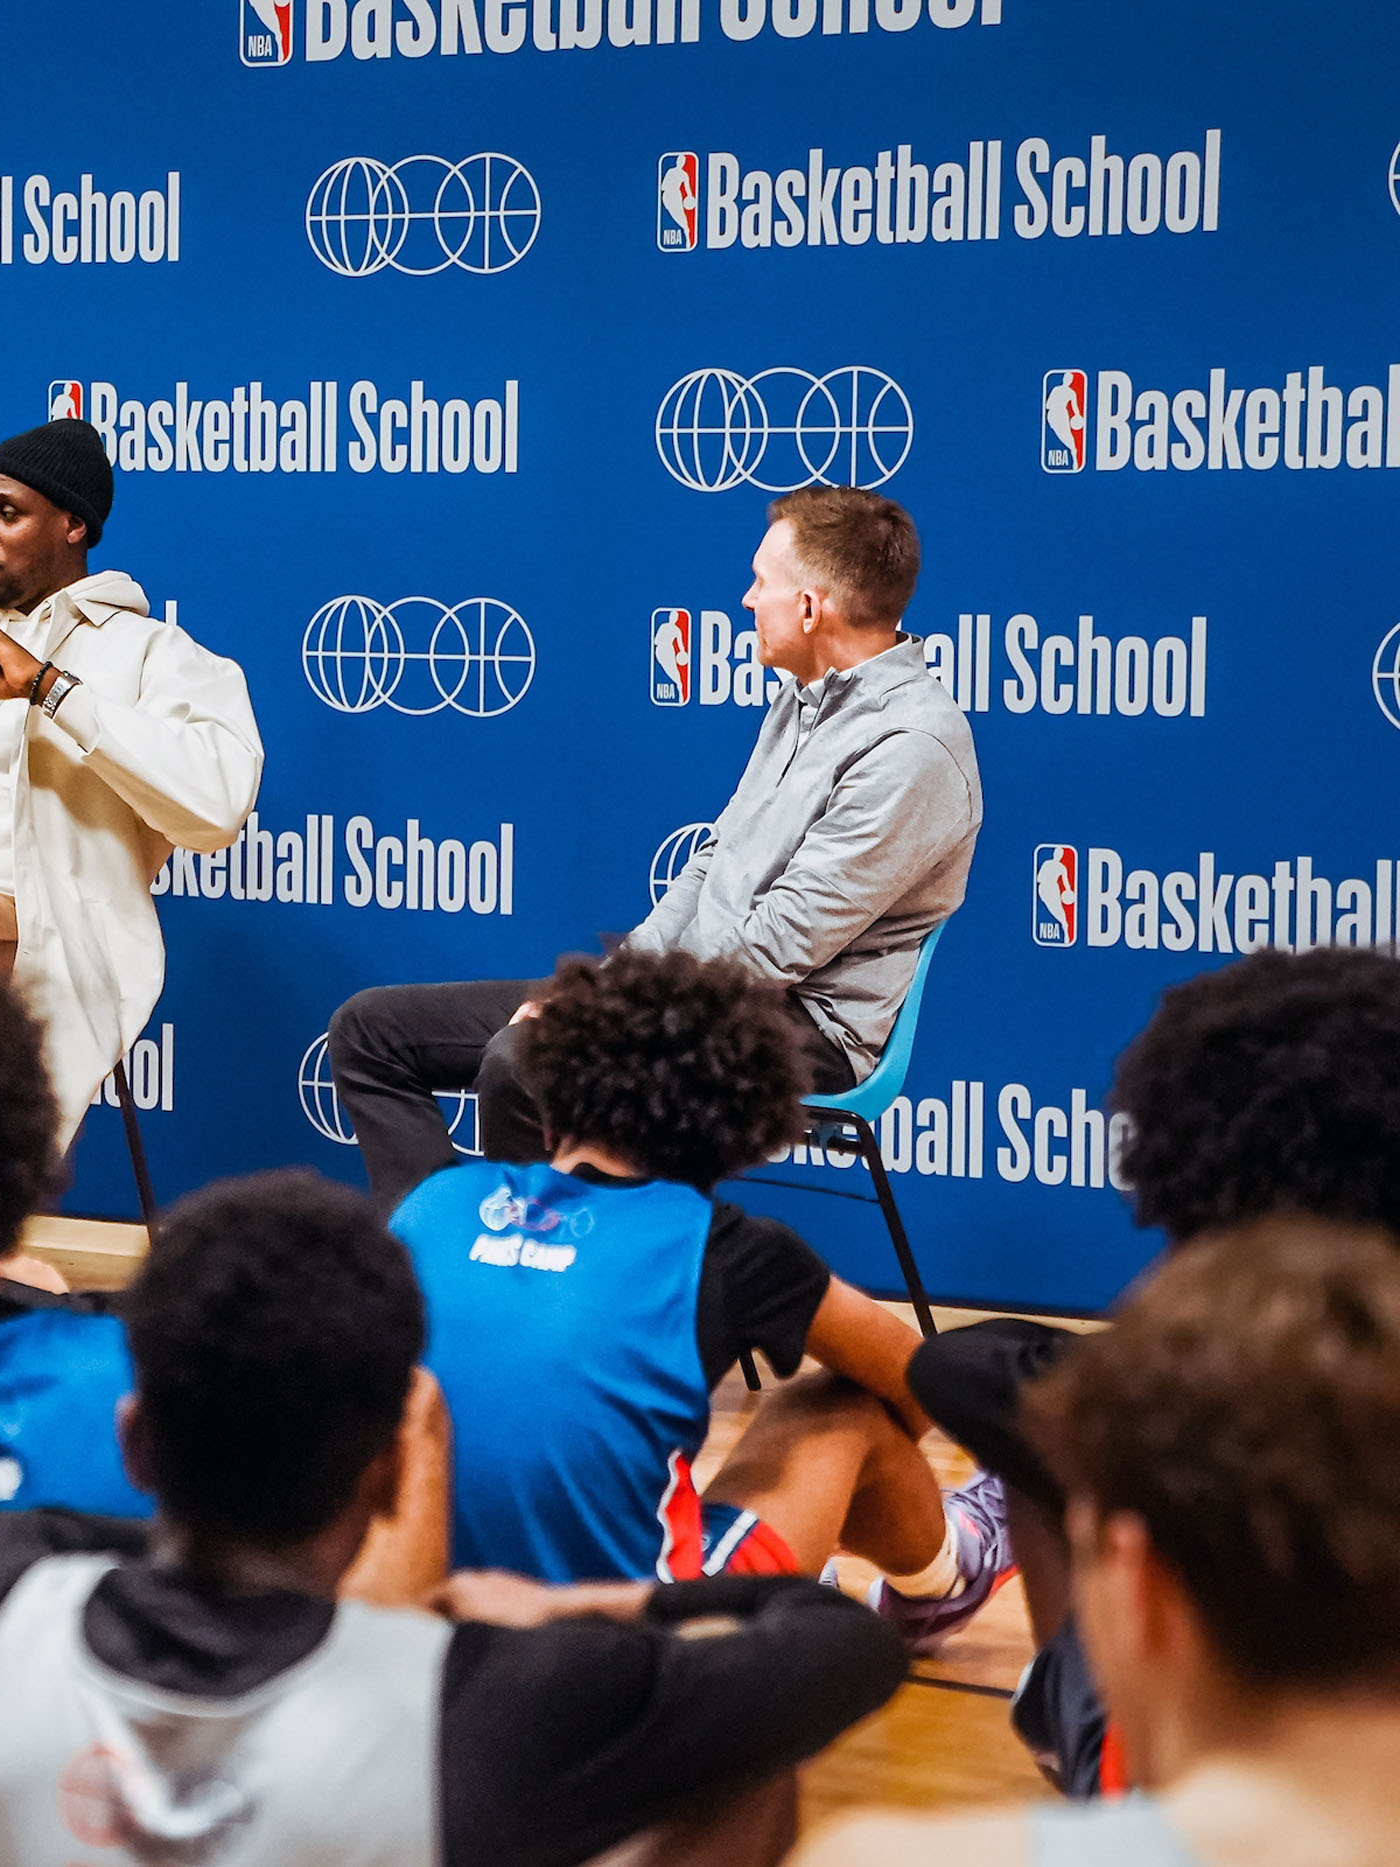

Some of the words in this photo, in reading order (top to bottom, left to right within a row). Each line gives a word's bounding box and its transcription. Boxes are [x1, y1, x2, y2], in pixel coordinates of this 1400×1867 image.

[248, 34, 273, 58] NBA
[23, 172, 180, 264] School
[706, 140, 1002, 249] Basketball
[1014, 129, 1221, 239] School
[663, 229, 683, 245] NBA
[90, 381, 338, 473] Basketball
[348, 380, 519, 474] School
[1048, 449, 1069, 466] NBA
[1095, 363, 1400, 471] Basketbal
[656, 683, 675, 699] NBA
[1003, 613, 1207, 717] School
[344, 815, 514, 915] School
[1087, 847, 1400, 956] Basketbal
[1039, 922, 1060, 939] NBA
[997, 1083, 1137, 1191] Scho
